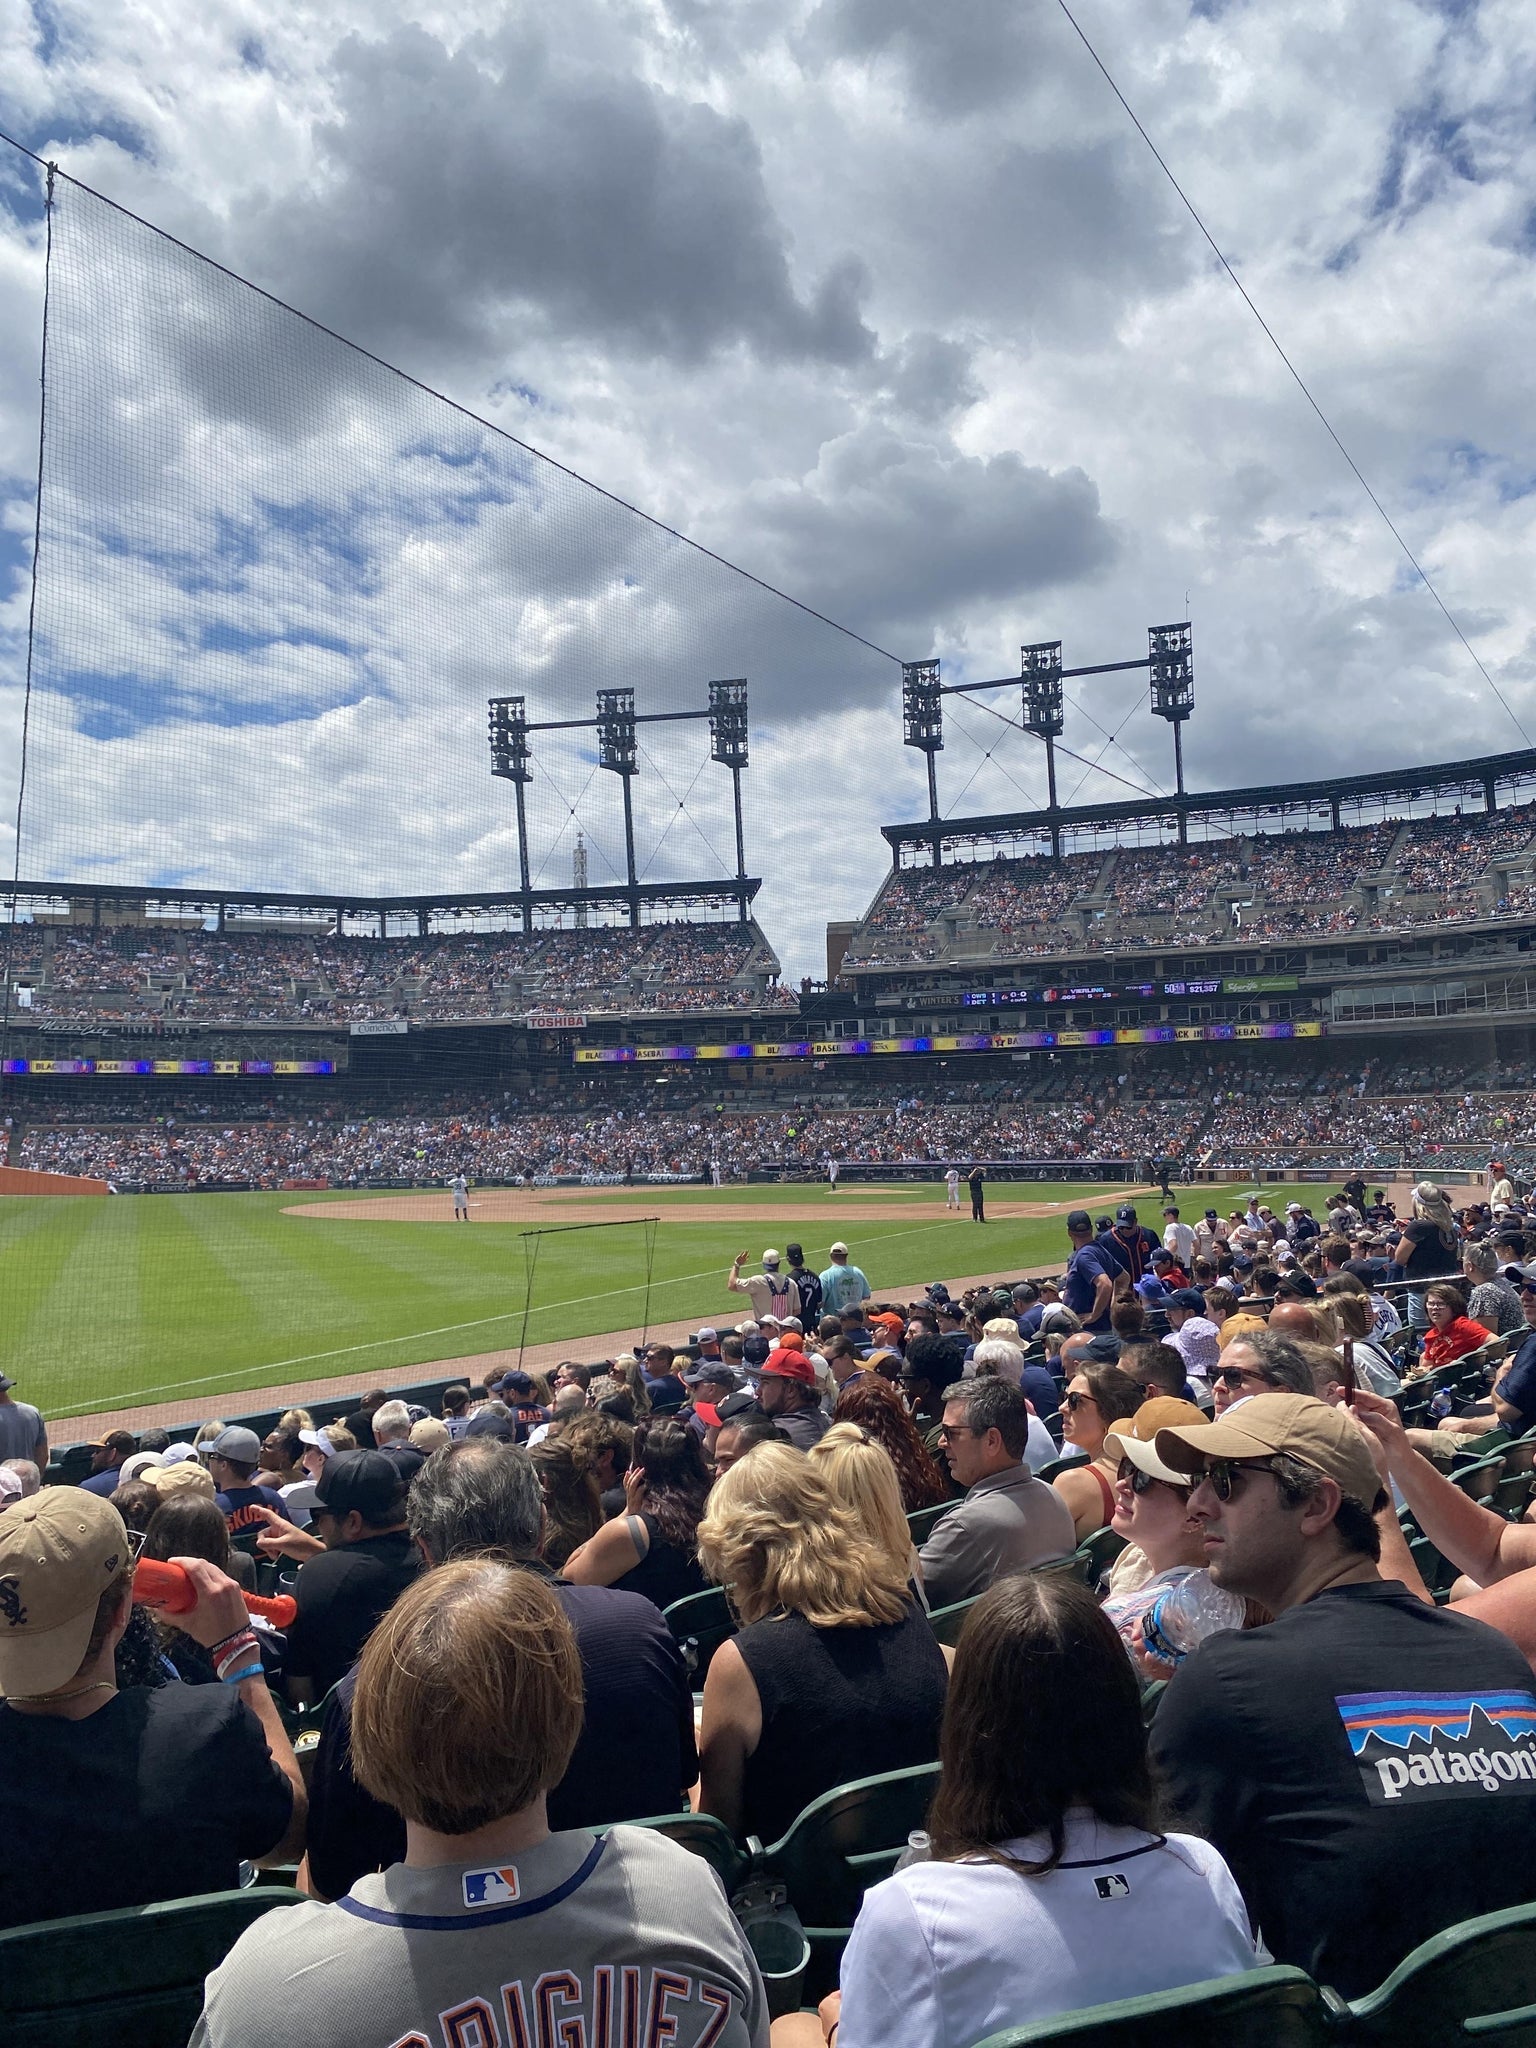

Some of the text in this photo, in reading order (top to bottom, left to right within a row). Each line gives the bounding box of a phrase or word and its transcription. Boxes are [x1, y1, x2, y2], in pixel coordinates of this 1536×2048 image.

[919, 995, 960, 1006] WINTER'S
[530, 1016, 584, 1028] TOSHIBA
[804, 1288, 813, 1308] 7
